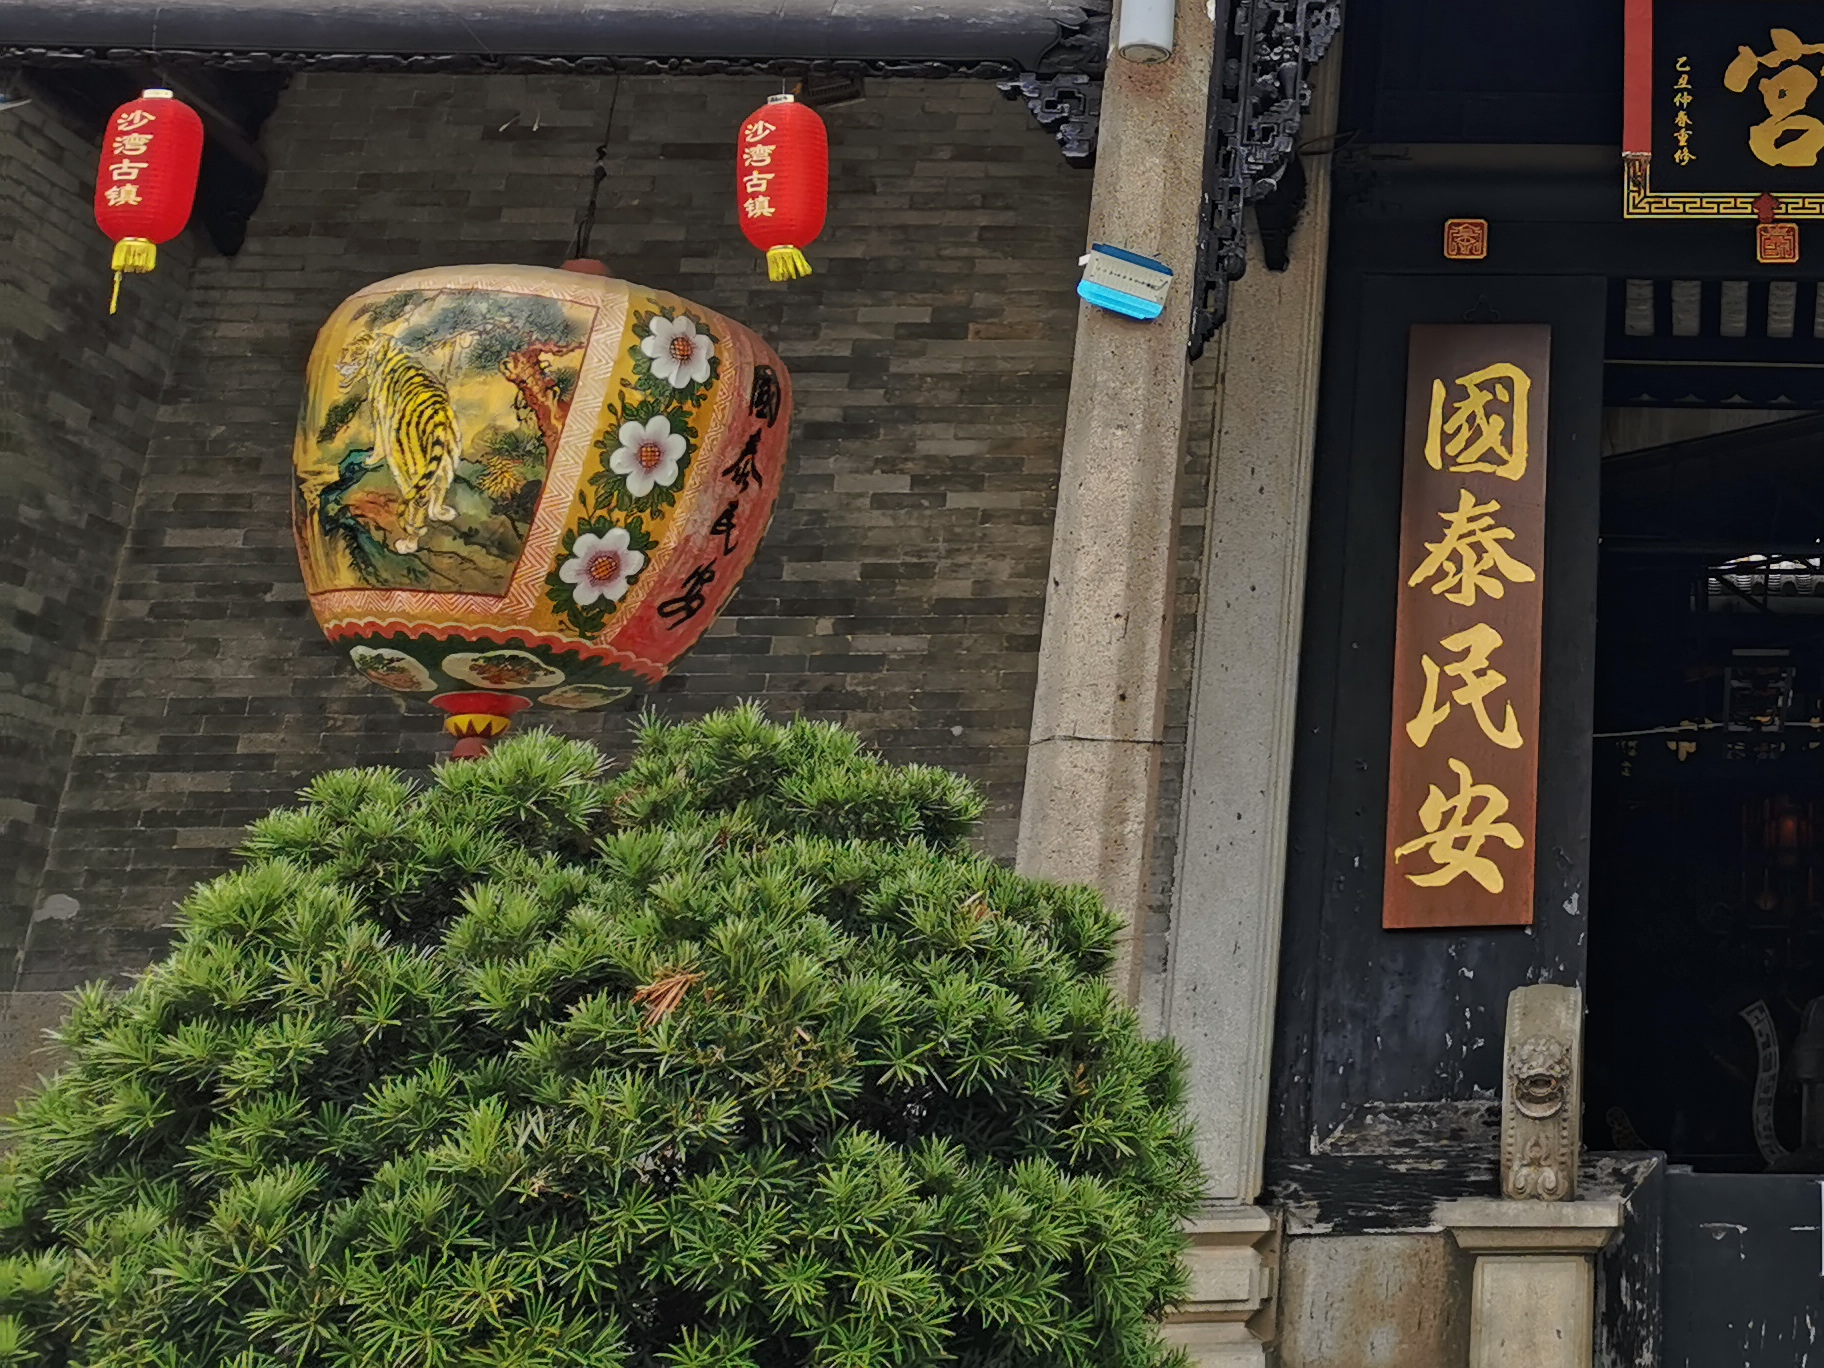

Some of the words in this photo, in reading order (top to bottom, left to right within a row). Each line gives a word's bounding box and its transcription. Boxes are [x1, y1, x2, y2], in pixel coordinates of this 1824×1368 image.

[104, 109, 157, 207] 沙湾古镇
[742, 119, 777, 219] 沙湾古镇
[1395, 362, 1536, 894] 國泰民安
